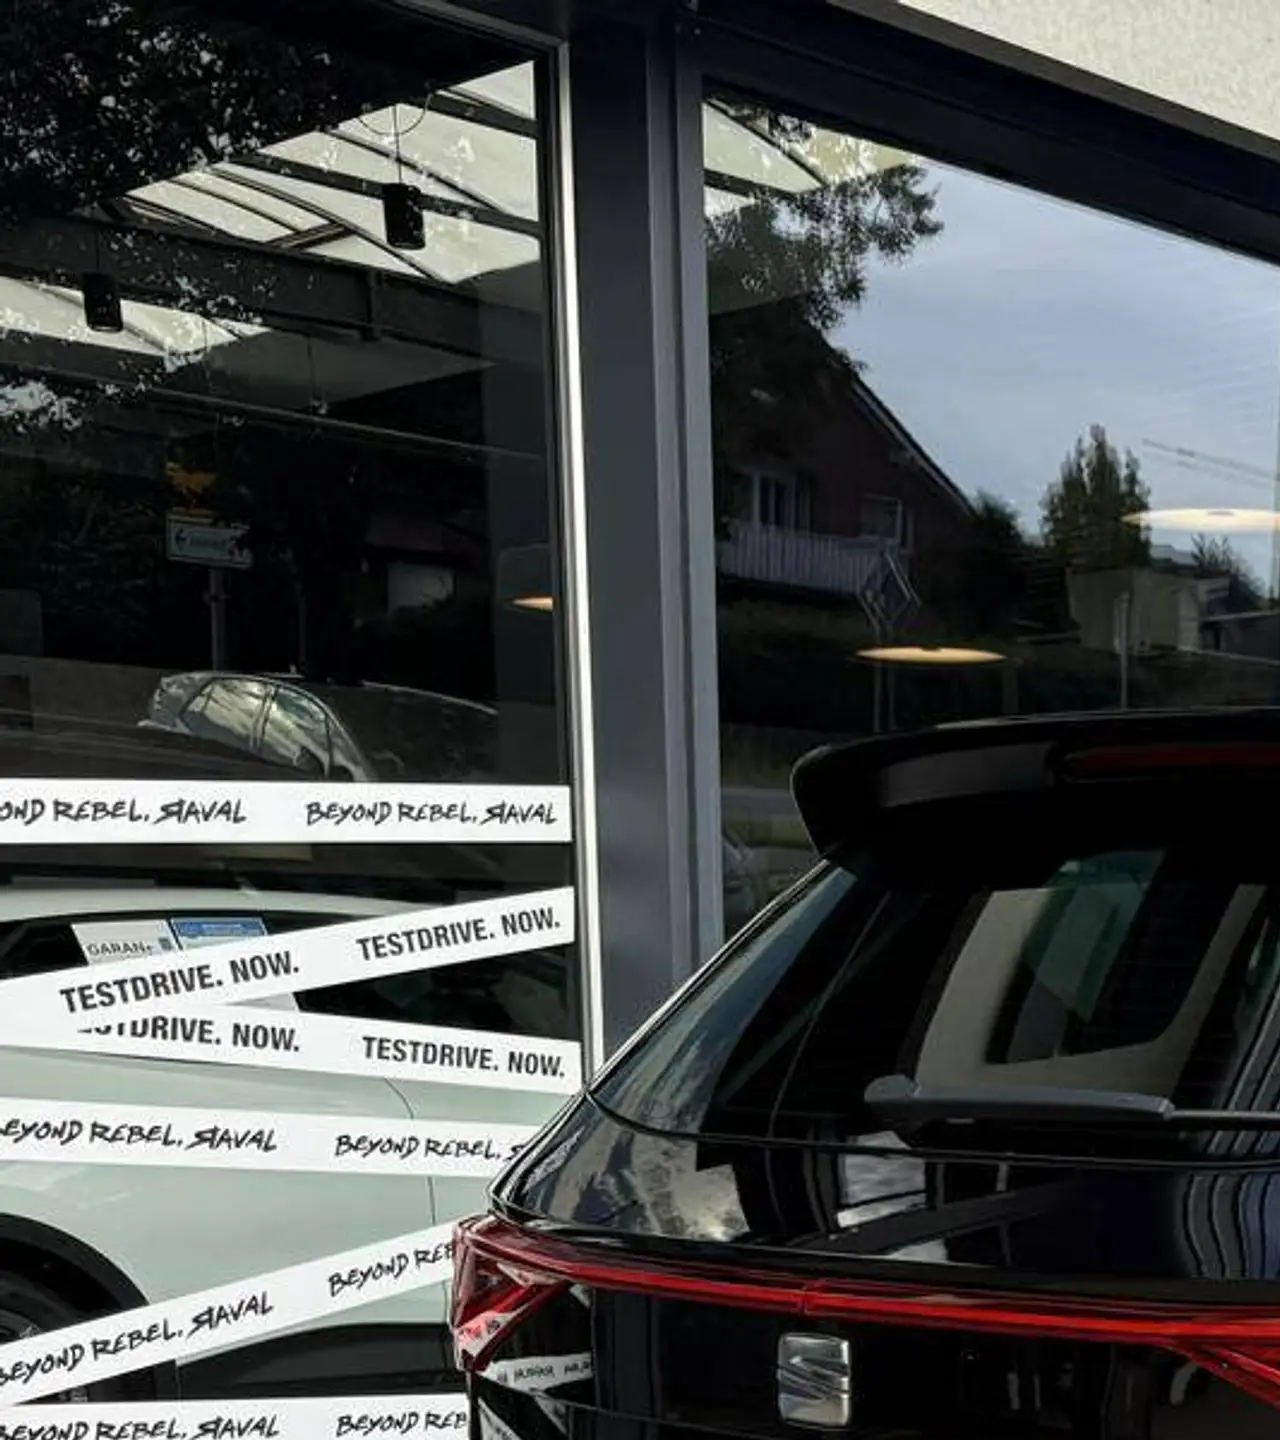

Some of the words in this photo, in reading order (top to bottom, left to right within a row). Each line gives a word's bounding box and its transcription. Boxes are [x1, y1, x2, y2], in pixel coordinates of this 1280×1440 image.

[53, 799, 149, 823] REBEL.
[306, 801, 392, 827] BEYOND
[399, 801, 477, 824] REBEL.
[356, 918, 495, 961] TESTDRIVE.
[501, 907, 561, 937] NOW.
[59, 964, 224, 1013] TESTDRIVE.
[229, 950, 301, 984] NOW.
[232, 1023, 301, 1052] NOW.
[362, 1035, 499, 1071] TESTDRIVE.
[508, 1050, 566, 1078] NOW.
[90, 1121, 183, 1147] REBEL.
[335, 1134, 420, 1159] BEYOND
[424, 1137, 501, 1160] REBEL.
[328, 1251, 410, 1297] BEYOND
[90, 1318, 184, 1358] REBEL.
[336, 1411, 419, 1437] BEYOND
